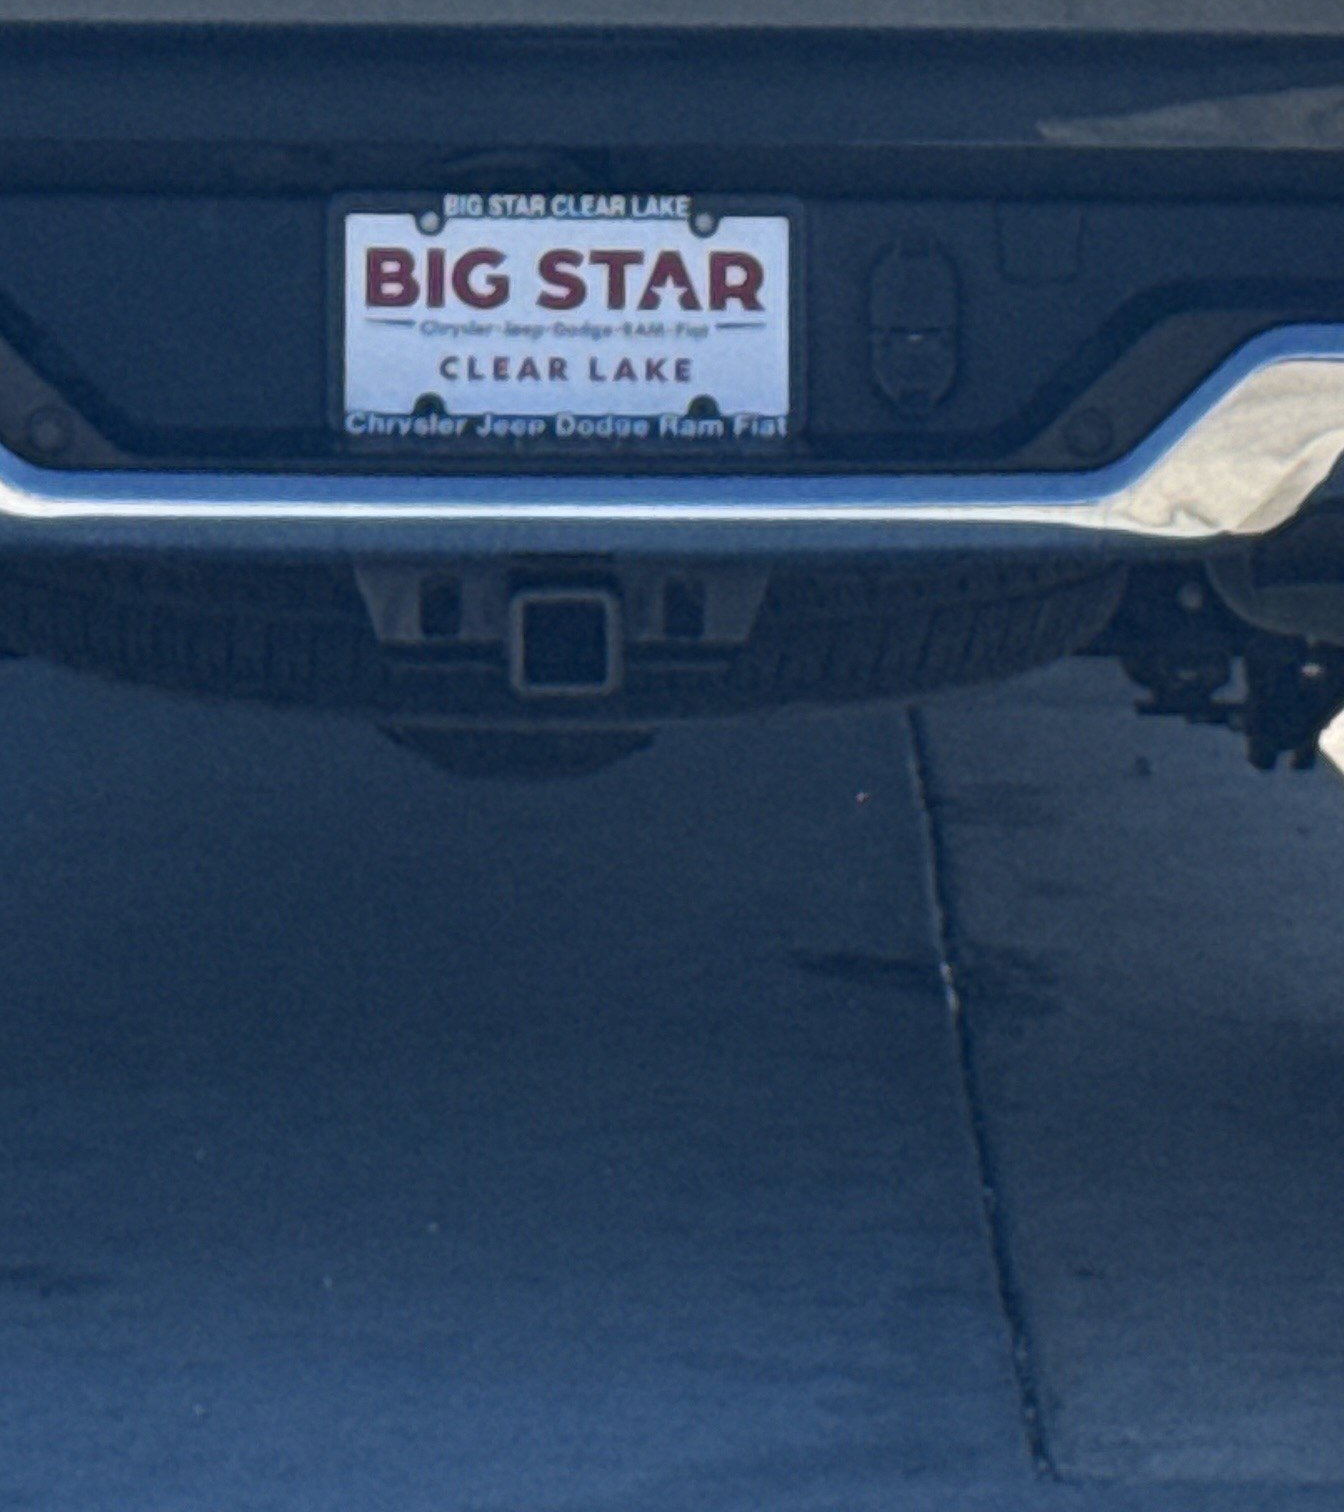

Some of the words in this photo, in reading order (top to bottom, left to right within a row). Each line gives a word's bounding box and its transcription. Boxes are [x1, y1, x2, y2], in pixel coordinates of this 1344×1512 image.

[444, 193, 483, 216] BIG
[488, 193, 546, 216] STAR
[551, 194, 626, 217] CLEAR
[631, 194, 691, 217] LAKE
[366, 247, 510, 309] BIG
[536, 248, 765, 311] STAR
[439, 356, 568, 381] CLEAR
[588, 357, 692, 383] LAKE
[345, 412, 466, 437] Chrysler
[476, 413, 546, 437] Jeep
[556, 413, 649, 438] Dodge
[659, 414, 724, 438] Ram
[733, 414, 787, 438] Fiat
